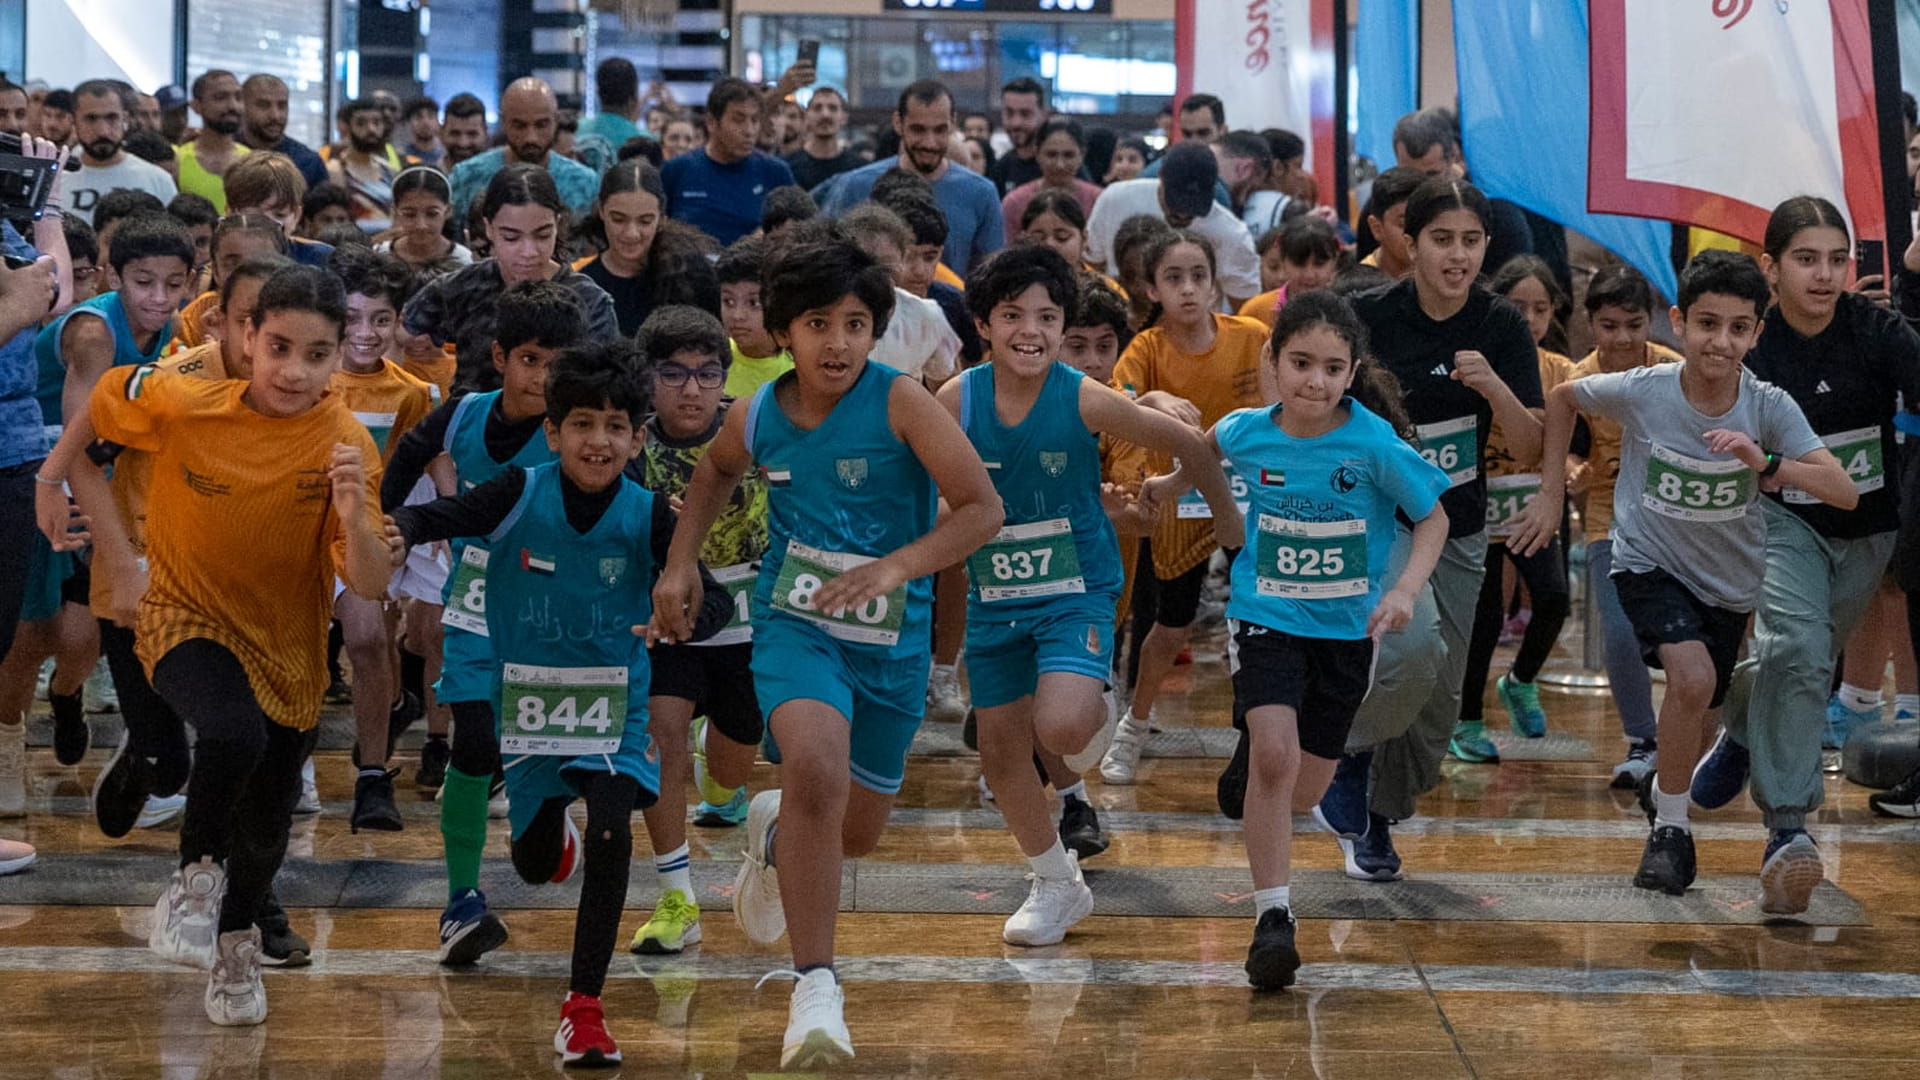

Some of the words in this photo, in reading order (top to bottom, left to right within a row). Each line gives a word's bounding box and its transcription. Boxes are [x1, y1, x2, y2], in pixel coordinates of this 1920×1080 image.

[1837, 449, 1872, 476] 4
[1658, 472, 1737, 506] 835
[1486, 494, 1537, 521] 81
[991, 548, 1052, 580] 837
[1277, 547, 1344, 575] 825
[788, 573, 888, 624] 80
[516, 695, 612, 733] 844
